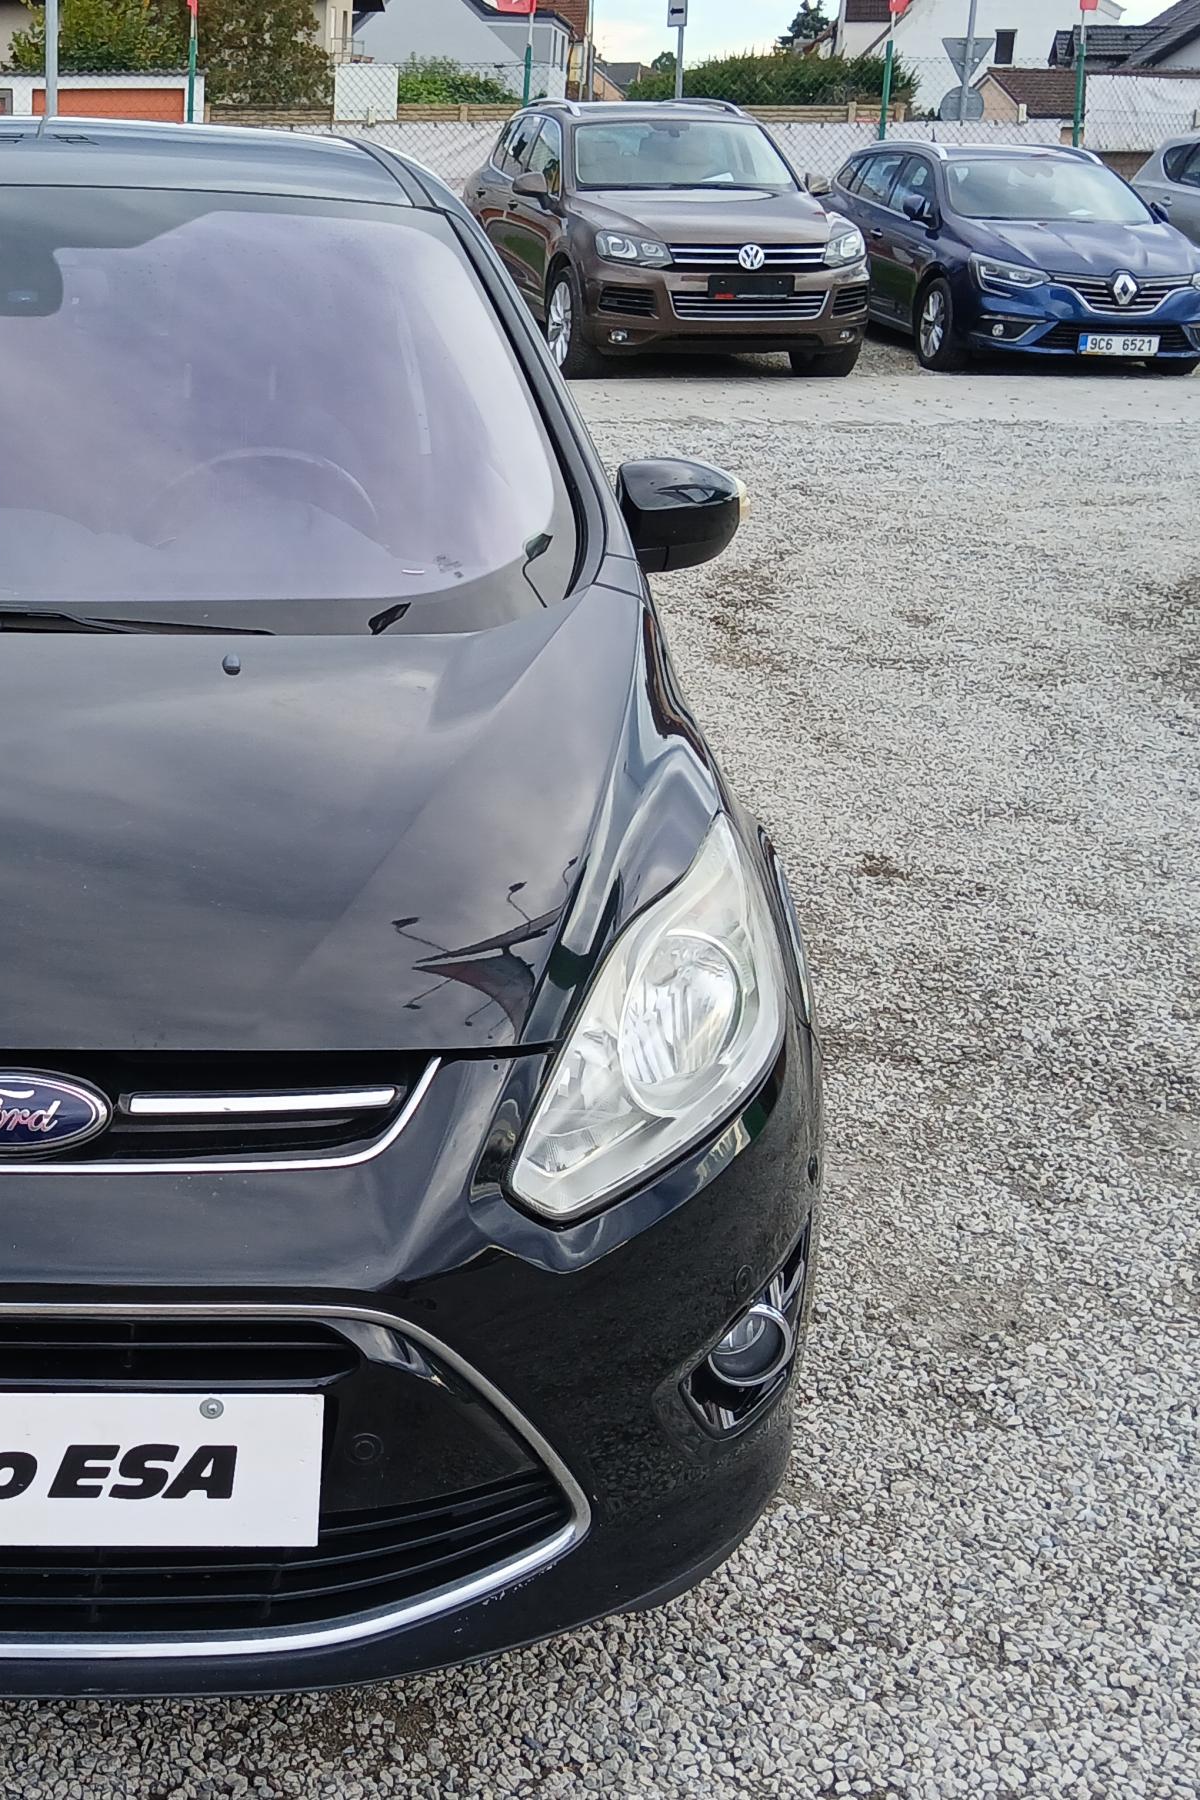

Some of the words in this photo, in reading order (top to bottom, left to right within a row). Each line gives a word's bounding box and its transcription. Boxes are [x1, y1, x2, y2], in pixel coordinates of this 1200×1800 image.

[1090, 337, 1113, 351] 9C6
[1122, 338, 1153, 352] 6521
[47, 1444, 238, 1499] ESA
